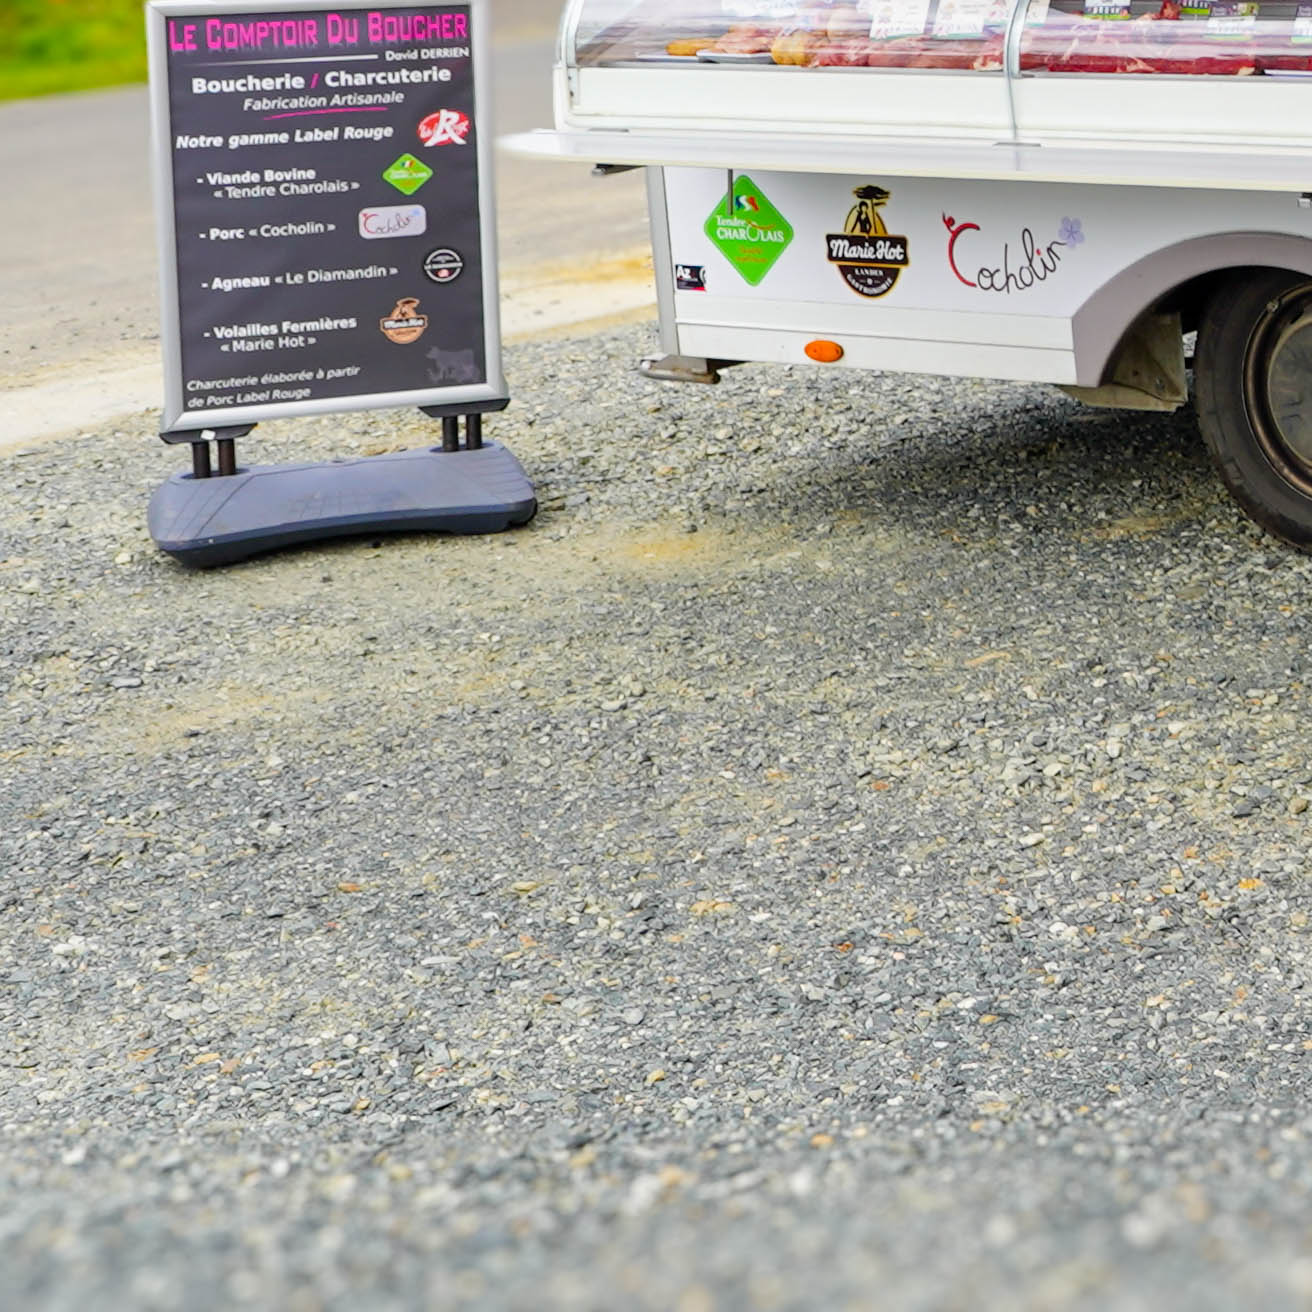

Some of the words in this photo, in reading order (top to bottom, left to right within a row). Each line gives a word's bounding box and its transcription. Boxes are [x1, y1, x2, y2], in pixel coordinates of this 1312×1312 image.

[169, 20, 198, 51] LE
[206, 17, 318, 50] COMPTOIR
[326, 13, 359, 43] DU
[367, 11, 468, 41] BOUCHER
[385, 50, 419, 62] David
[420, 47, 470, 60] DERRIEN
[191, 73, 305, 94] Boucherie
[325, 65, 452, 88] Charcuterie
[243, 94, 328, 111] Fabrication
[329, 91, 405, 108] Artisanale
[176, 134, 224, 149] Notre
[228, 134, 290, 150] gamme
[294, 127, 339, 143] Label
[343, 126, 394, 142] Rouge
[206, 169, 261, 186] Viande
[263, 168, 316, 182] Bovine
[224, 185, 276, 199] Tendre
[279, 179, 349, 196] Charolais
[209, 227, 245, 240] Porc
[259, 222, 325, 238] Cocholin
[715, 223, 785, 243] CHAROLAIS
[829, 239, 875, 259] Marie
[875, 240, 905, 260] Hot
[944, 215, 1068, 295] Cocholin
[211, 274, 271, 292] Agneau
[285, 272, 304, 285] Le
[306, 264, 387, 283] Diamandin
[213, 322, 279, 339] Volailles
[281, 316, 358, 333] Fermières
[232, 337, 275, 352] Marie
[278, 335, 305, 349] Hot
[186, 375, 258, 391] Charcuterie
[260, 369, 315, 385] élaborée
[315, 368, 325, 380] à
[326, 364, 361, 382] partir
[187, 395, 204, 408] de
[206, 393, 234, 407] Porc
[236, 390, 270, 404] Label
[272, 387, 312, 401] Rouge
